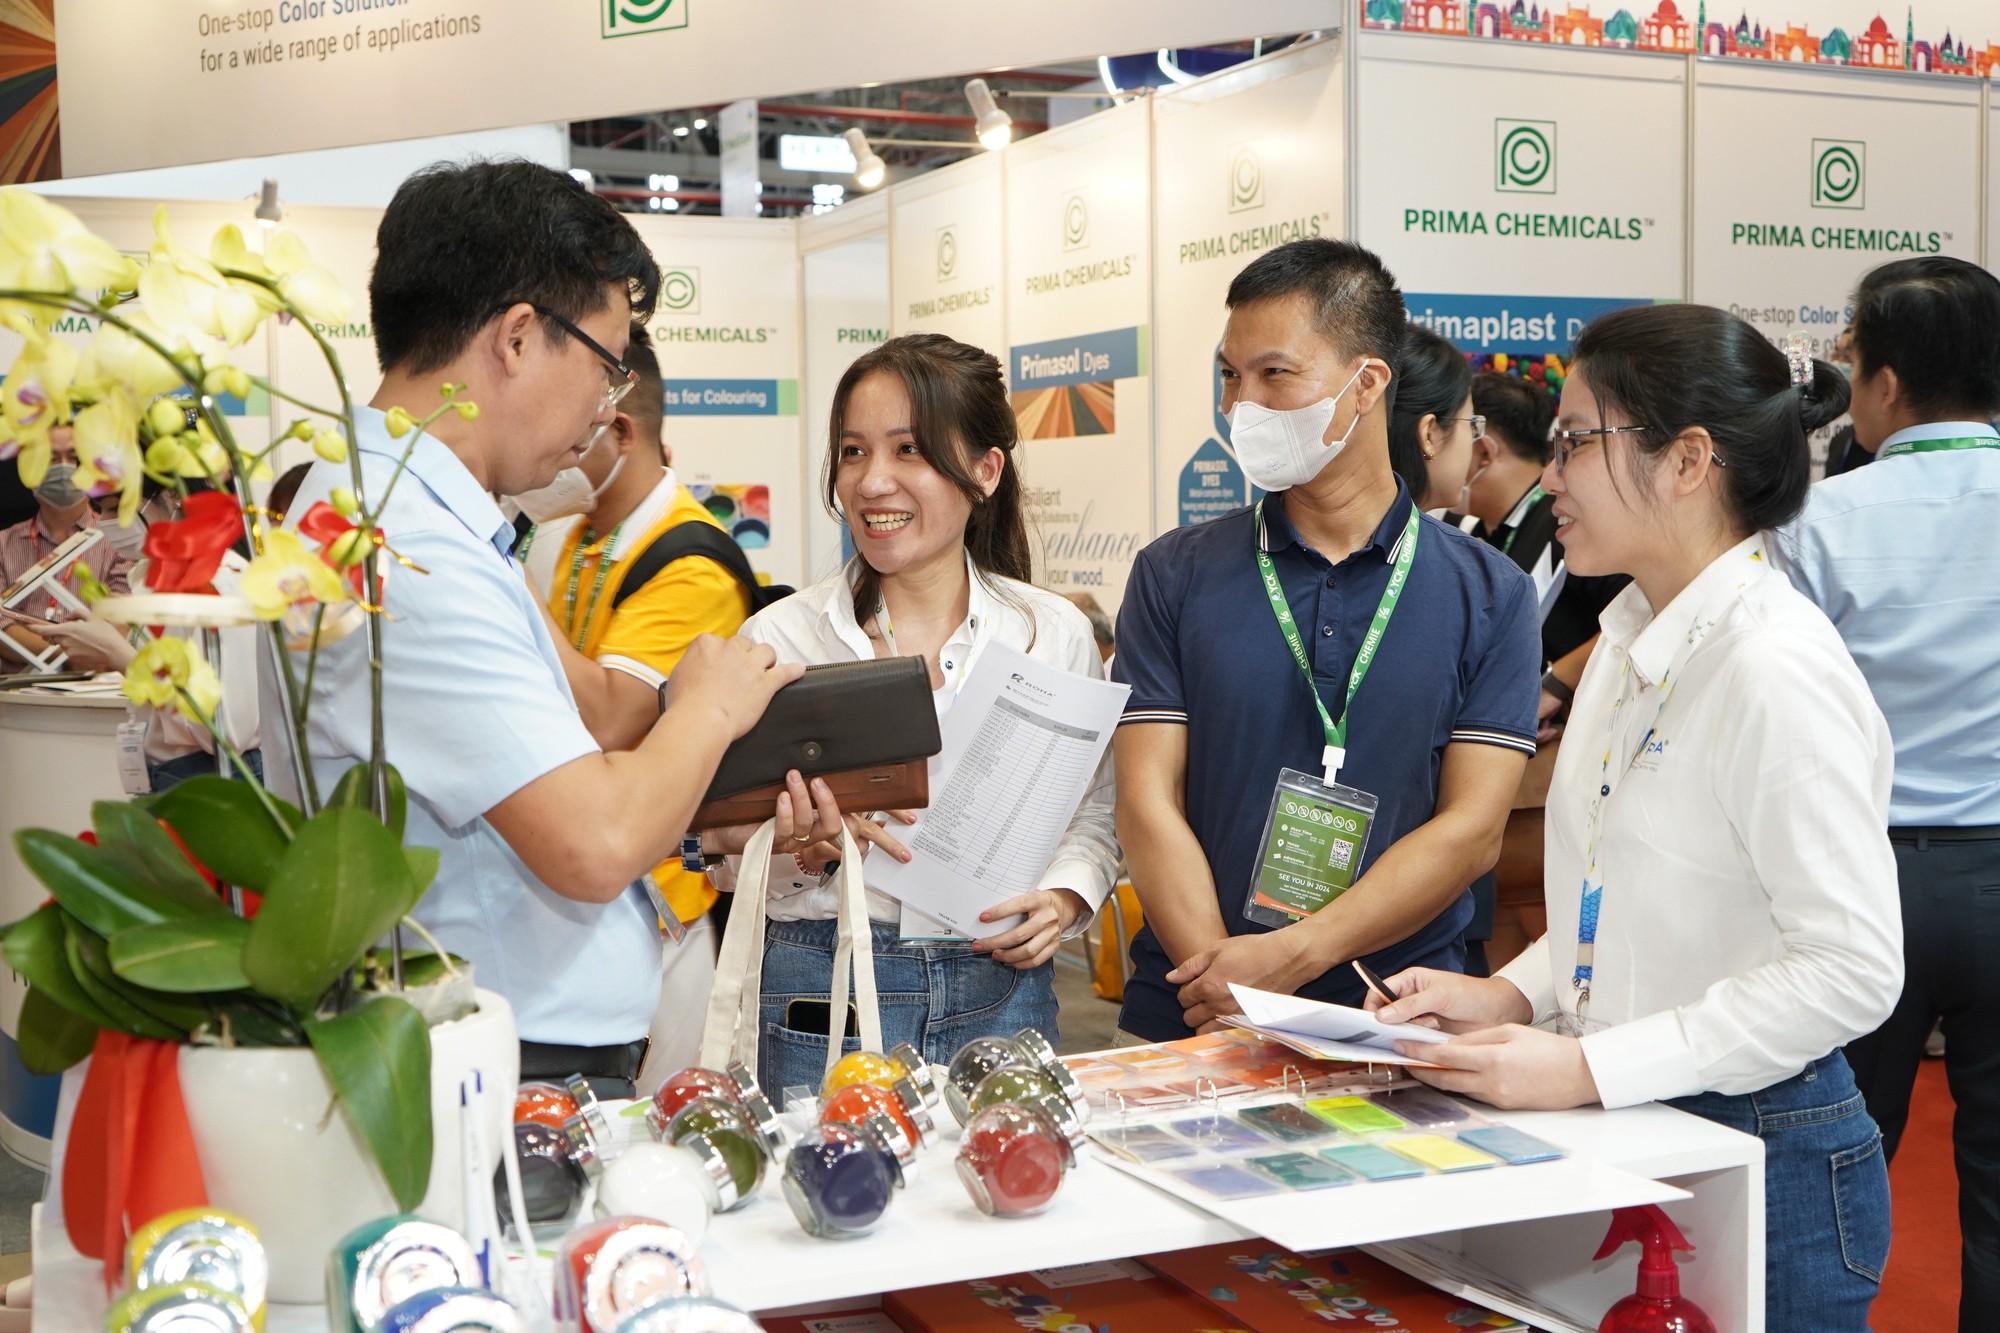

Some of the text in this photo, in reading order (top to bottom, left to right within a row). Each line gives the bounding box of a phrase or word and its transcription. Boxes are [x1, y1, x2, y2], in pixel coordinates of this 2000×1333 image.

[199, 8, 273, 36] One-stop
[279, 0, 326, 24] Color
[200, 14, 481, 72] for a wide range of applications
[1404, 208, 1488, 235] PRIMA
[1732, 223, 1805, 248] PRIMA
[1180, 236, 1226, 265] PRIMA
[1025, 275, 1061, 295] PRIMA
[908, 301, 936, 321] PRIMA
[1800, 305, 1839, 325] Color
[314, 323, 372, 339] PRIM
[1020, 348, 1110, 380] Primasol Dyes
[682, 389, 701, 404] for
[703, 389, 767, 408] Colouring
[1046, 498, 1141, 563] enhance
[1400, 532, 1416, 564] CHEMIE
[1265, 572, 1279, 593] YCK
[1288, 632, 1308, 669] CHEMIE
[1359, 627, 1381, 664] CHEMIE
[1278, 873, 1290, 882] SEE
[1292, 876, 1306, 886] YOU
[1306, 880, 1314, 888] IN
[1315, 883, 1330, 893] 2024
